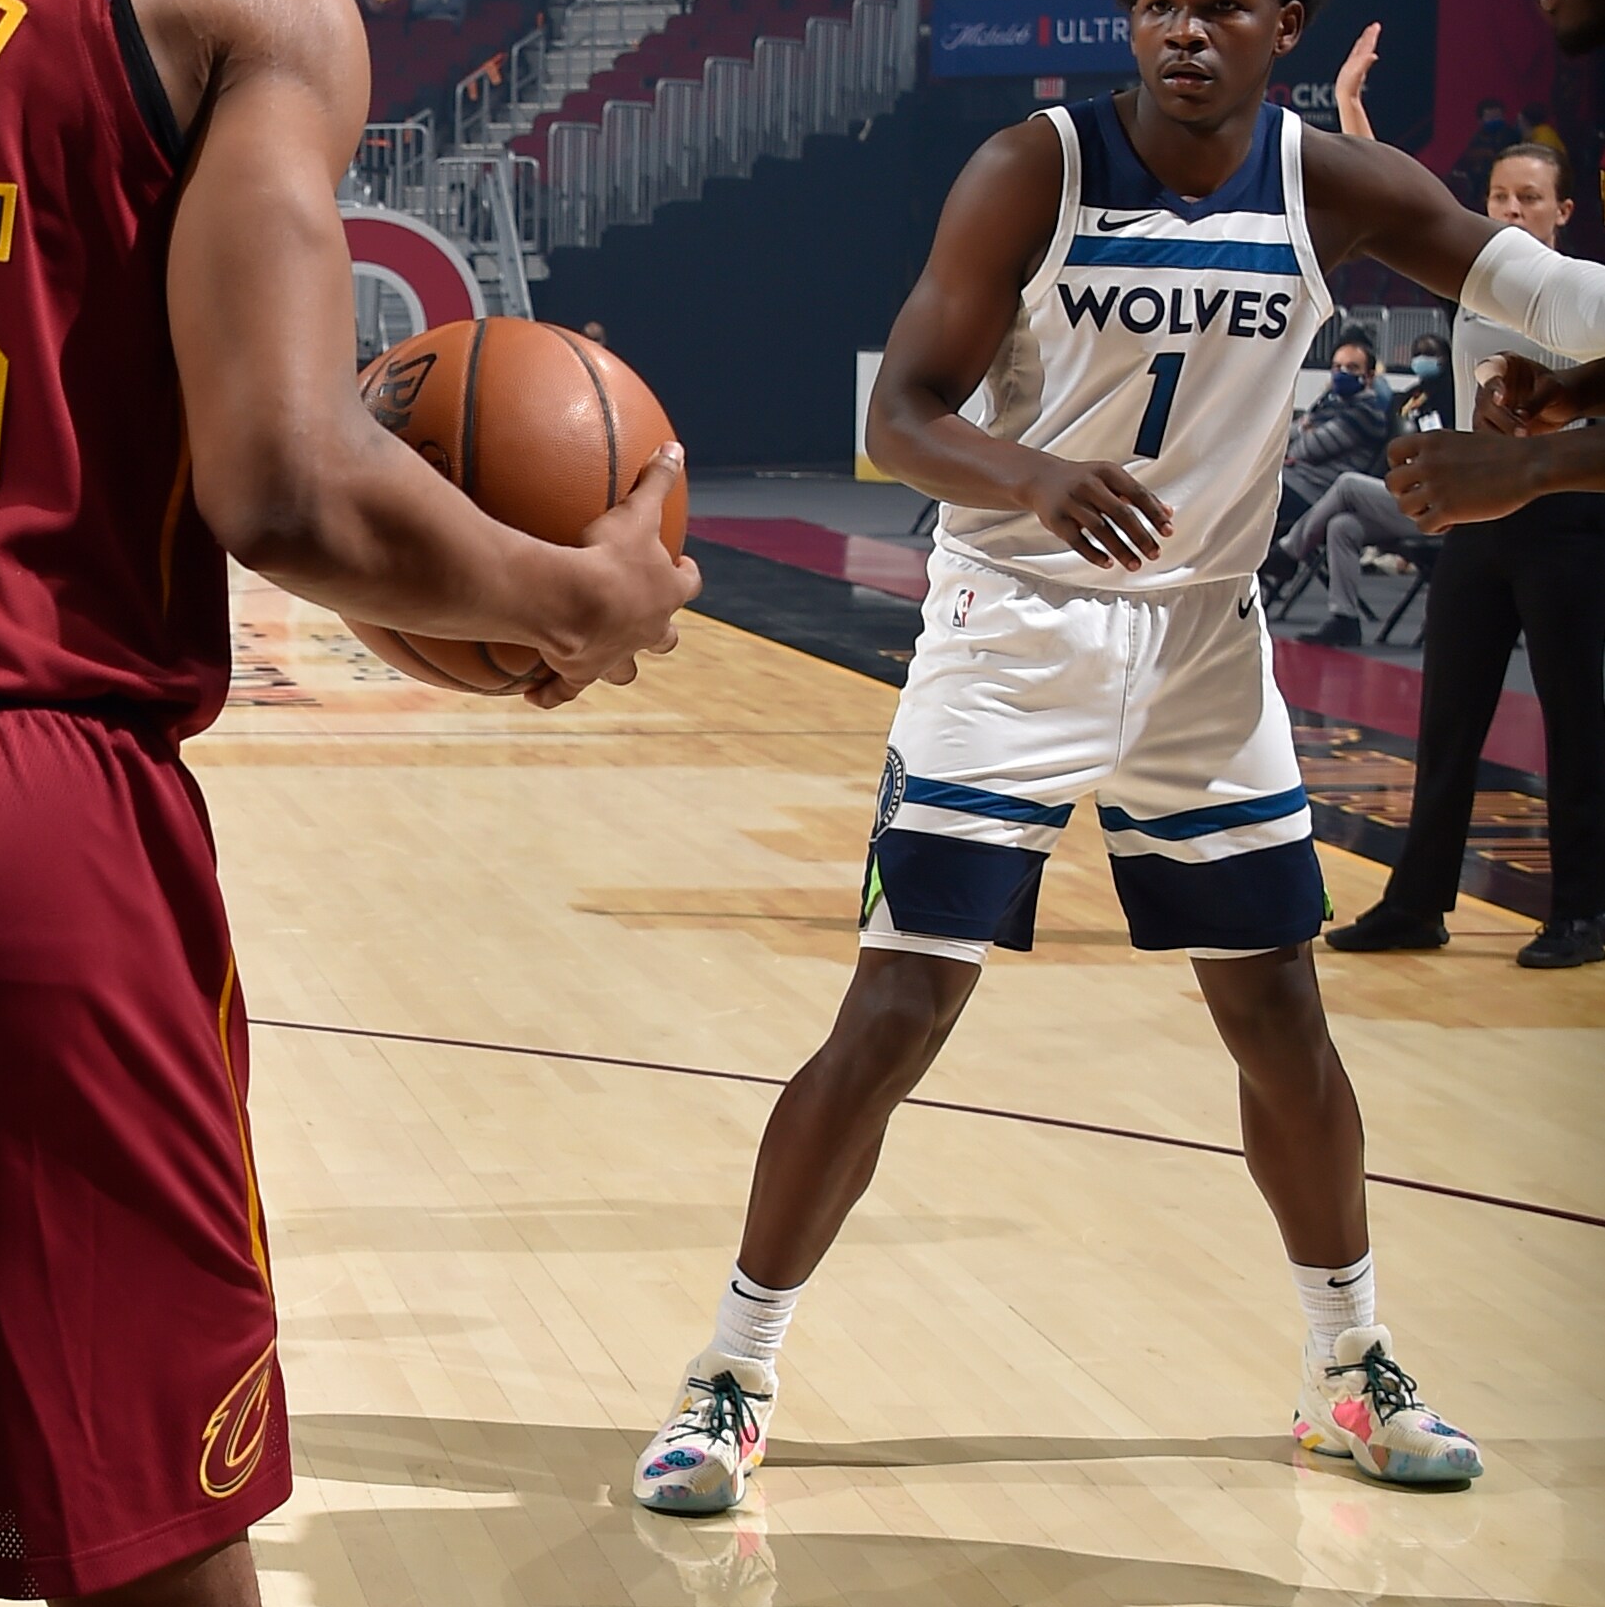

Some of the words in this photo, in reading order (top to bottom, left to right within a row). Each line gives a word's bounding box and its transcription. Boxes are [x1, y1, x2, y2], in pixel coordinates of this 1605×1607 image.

[1056, 16, 1131, 44] ULTR
[1057, 283, 1292, 340] WOLVES
[1132, 352, 1186, 460] 1
